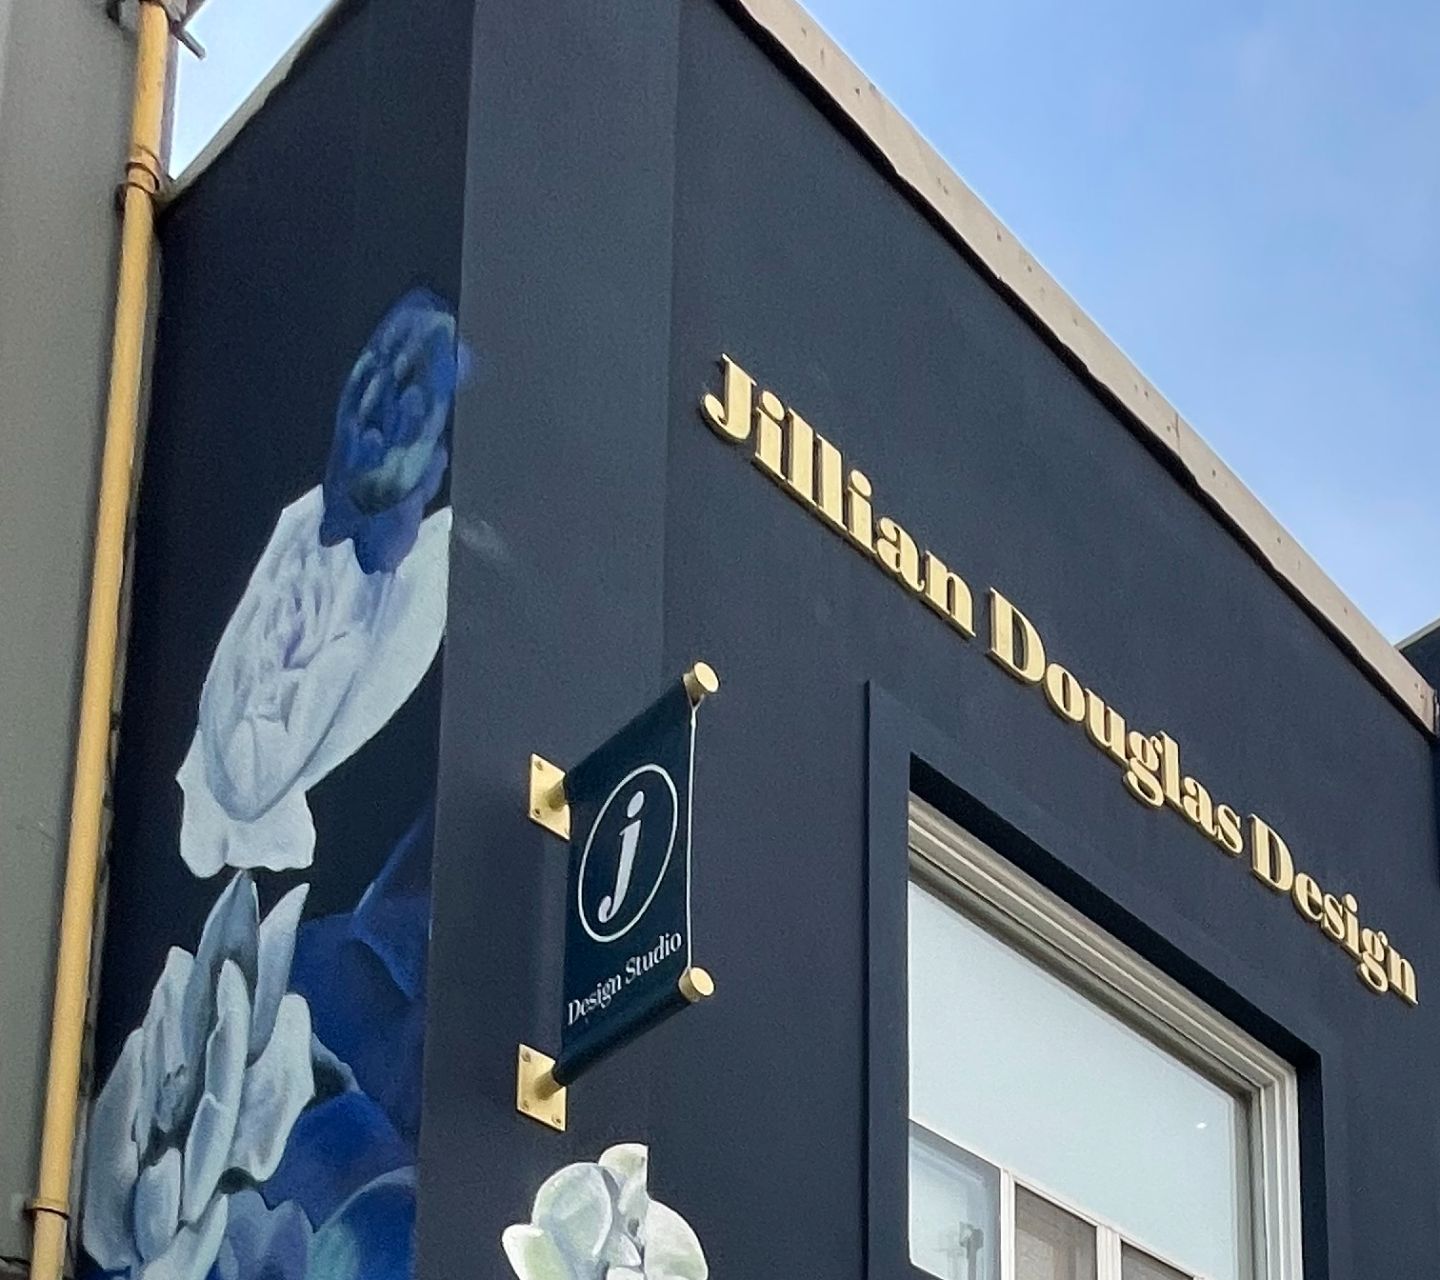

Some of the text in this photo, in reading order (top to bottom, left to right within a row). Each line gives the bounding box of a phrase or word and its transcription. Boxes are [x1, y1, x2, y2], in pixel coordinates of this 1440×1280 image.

[701, 353, 1418, 1006] Jillian Douglas Design
[567, 932, 682, 1026] Design Studio
